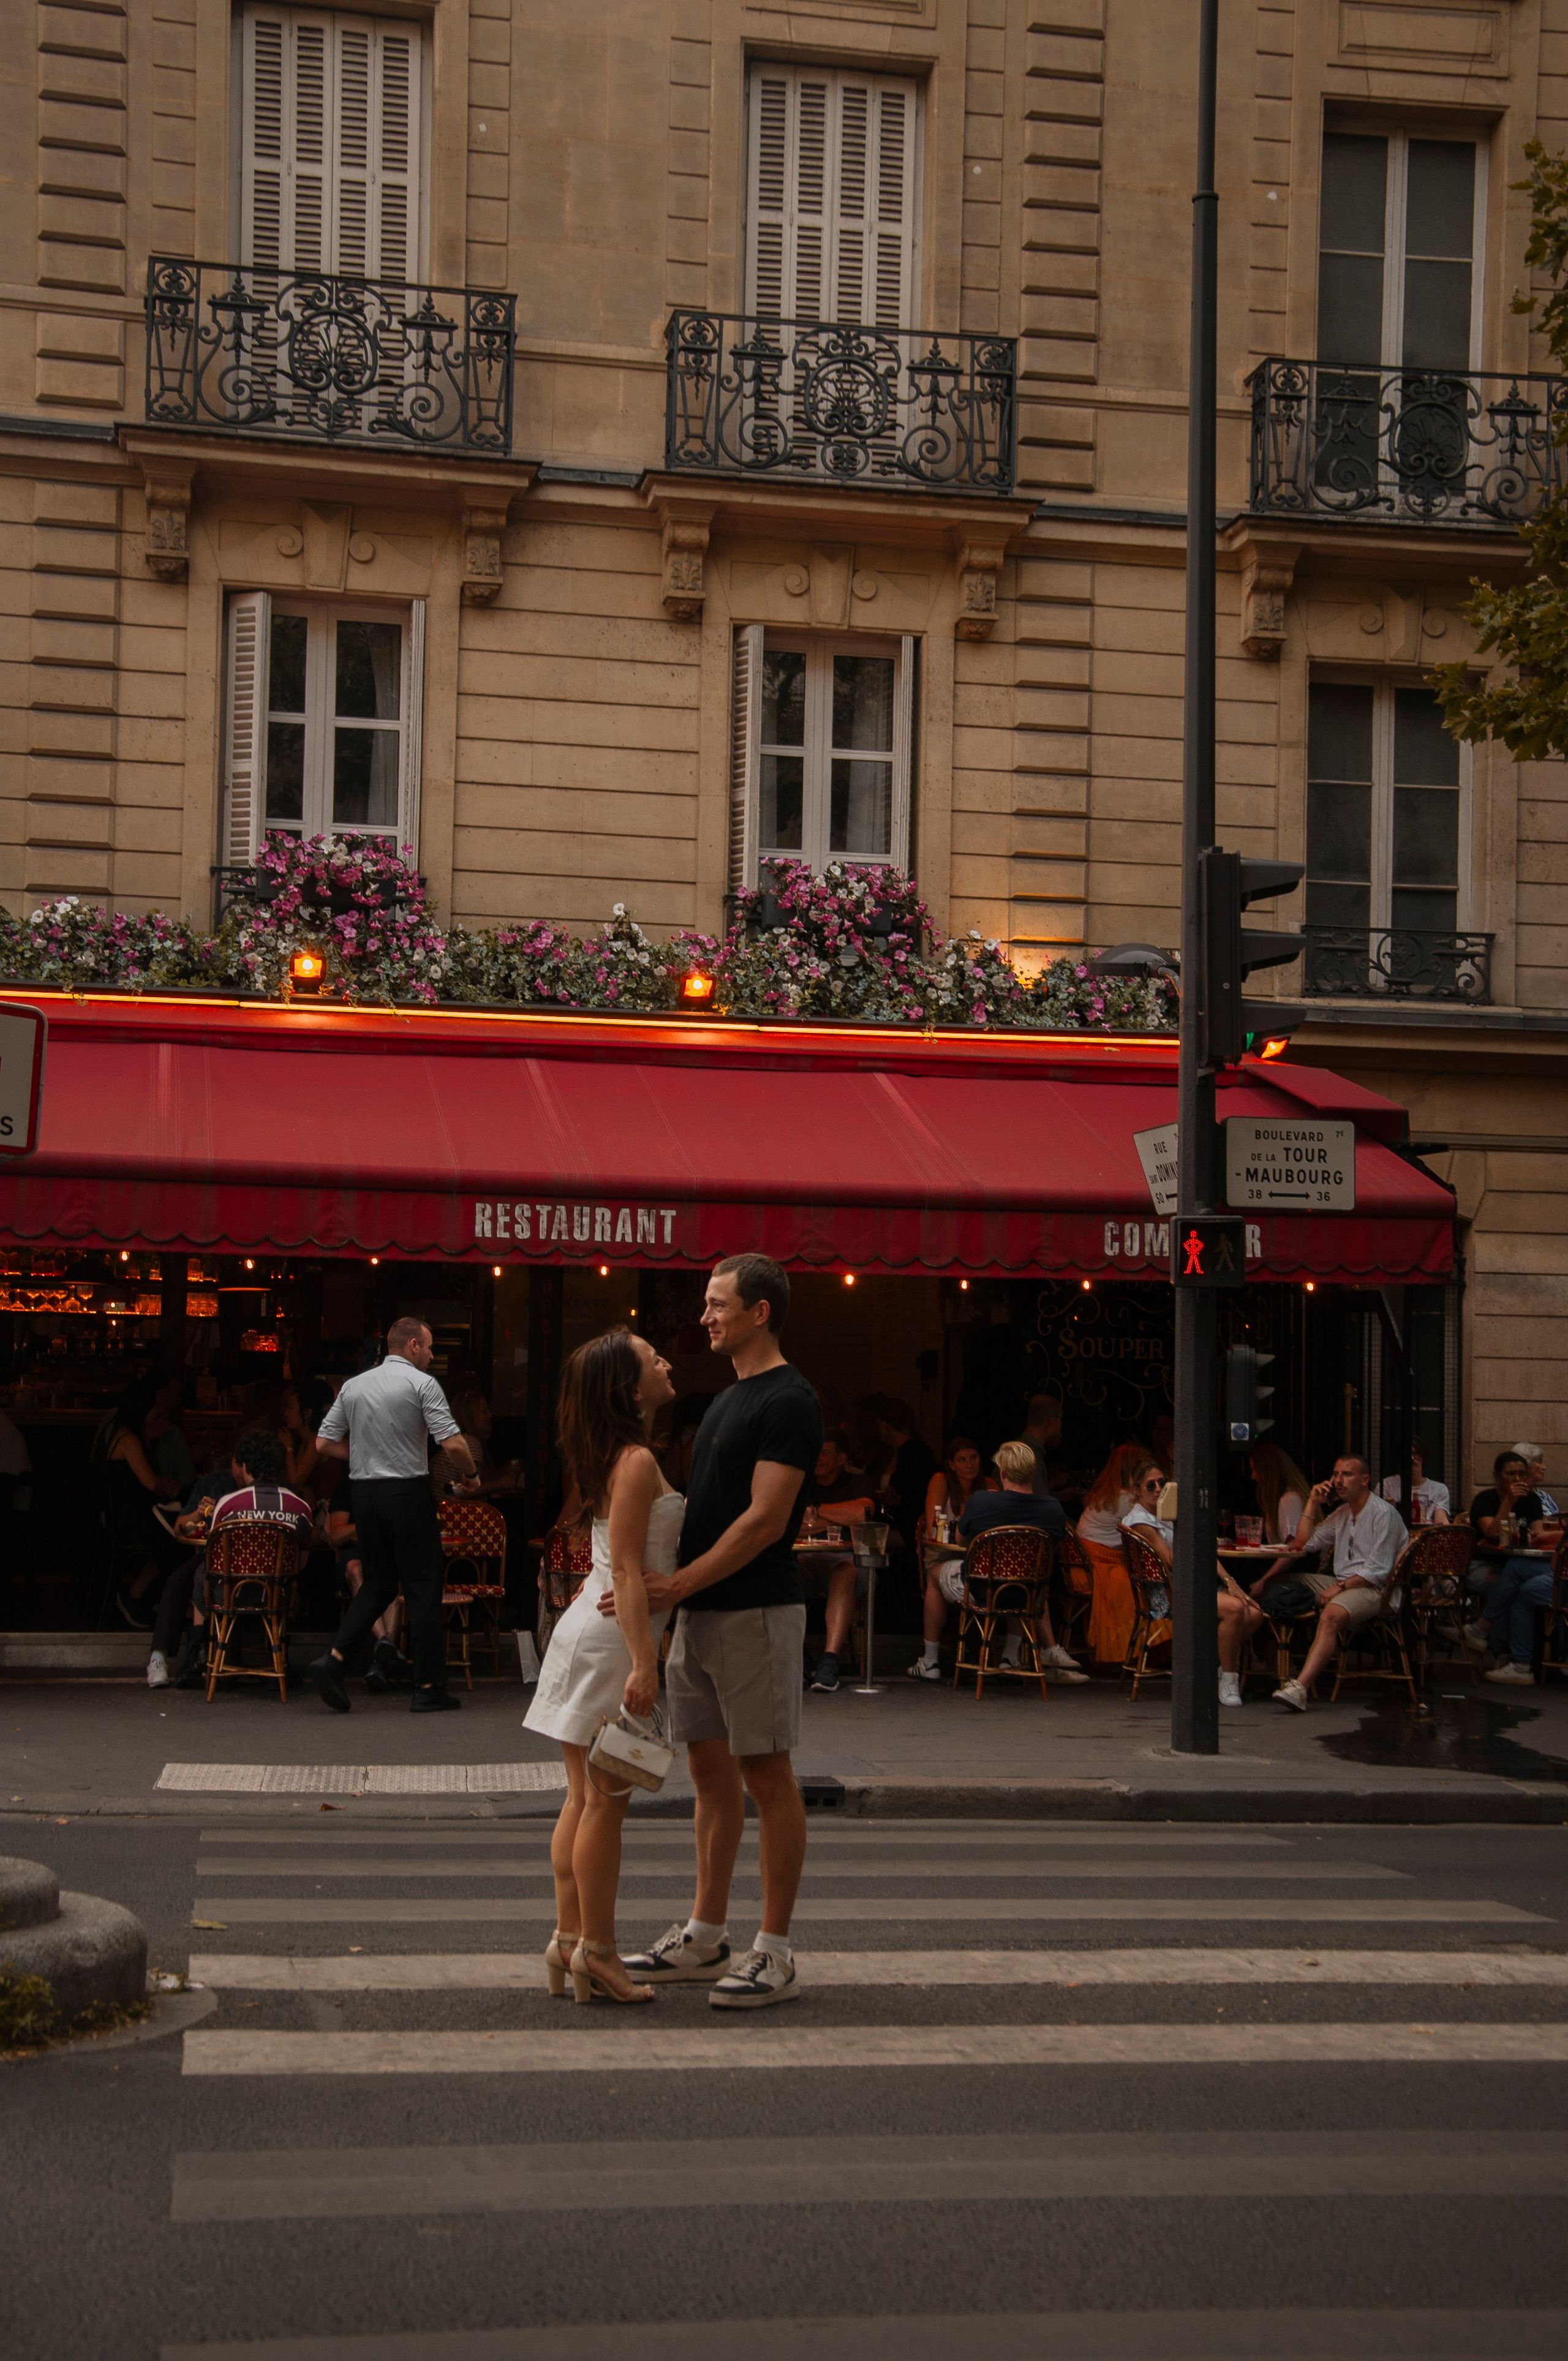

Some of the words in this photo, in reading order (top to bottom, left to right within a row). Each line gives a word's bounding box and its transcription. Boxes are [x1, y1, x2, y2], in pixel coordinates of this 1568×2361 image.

[1255, 1129, 1324, 1142] BOULEVARD
[1153, 1141, 1167, 1155] RUE
[1251, 1153, 1262, 1161] DE
[1266, 1153, 1276, 1162] LA
[1283, 1147, 1327, 1163] TOUR
[1156, 1192, 1164, 1204] 50
[1248, 1189, 1262, 1199] 38
[1317, 1192, 1330, 1202] 36
[475, 1202, 676, 1244] RESTAURANT
[1104, 1221, 1261, 1257] COMR
[1057, 1328, 1166, 1360] SOUPER
[238, 1510, 265, 1519] NEW
[268, 1511, 299, 1524] YORK
